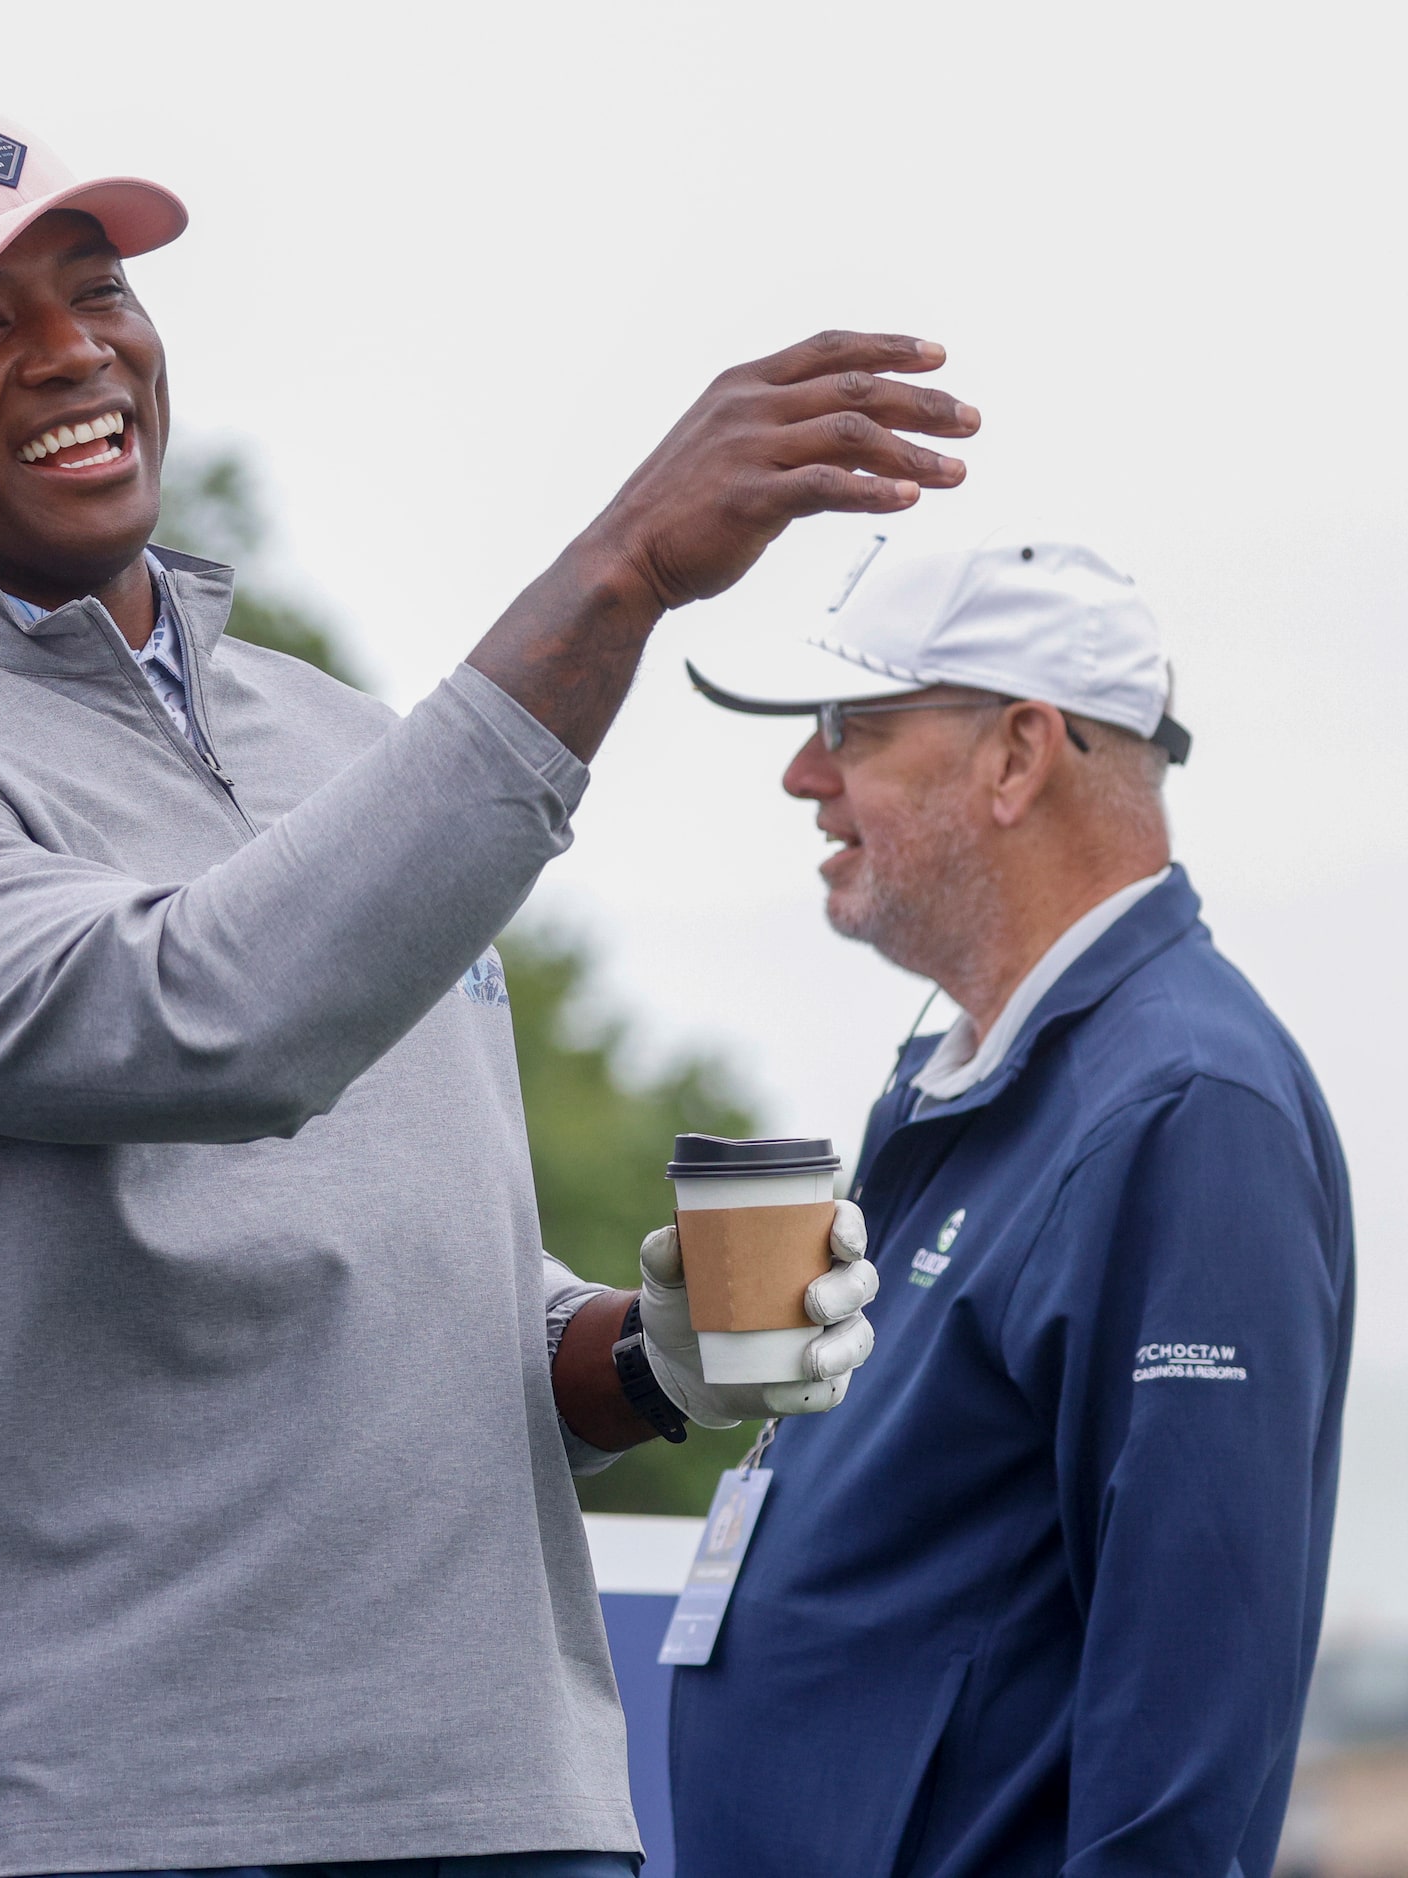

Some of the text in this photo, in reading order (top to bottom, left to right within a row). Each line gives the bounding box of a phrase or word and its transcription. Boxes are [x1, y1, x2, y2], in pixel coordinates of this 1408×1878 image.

[1136, 1343, 1236, 1364] CHOCTAW
[1132, 1364, 1247, 1382] CASINOS & RESORTS
